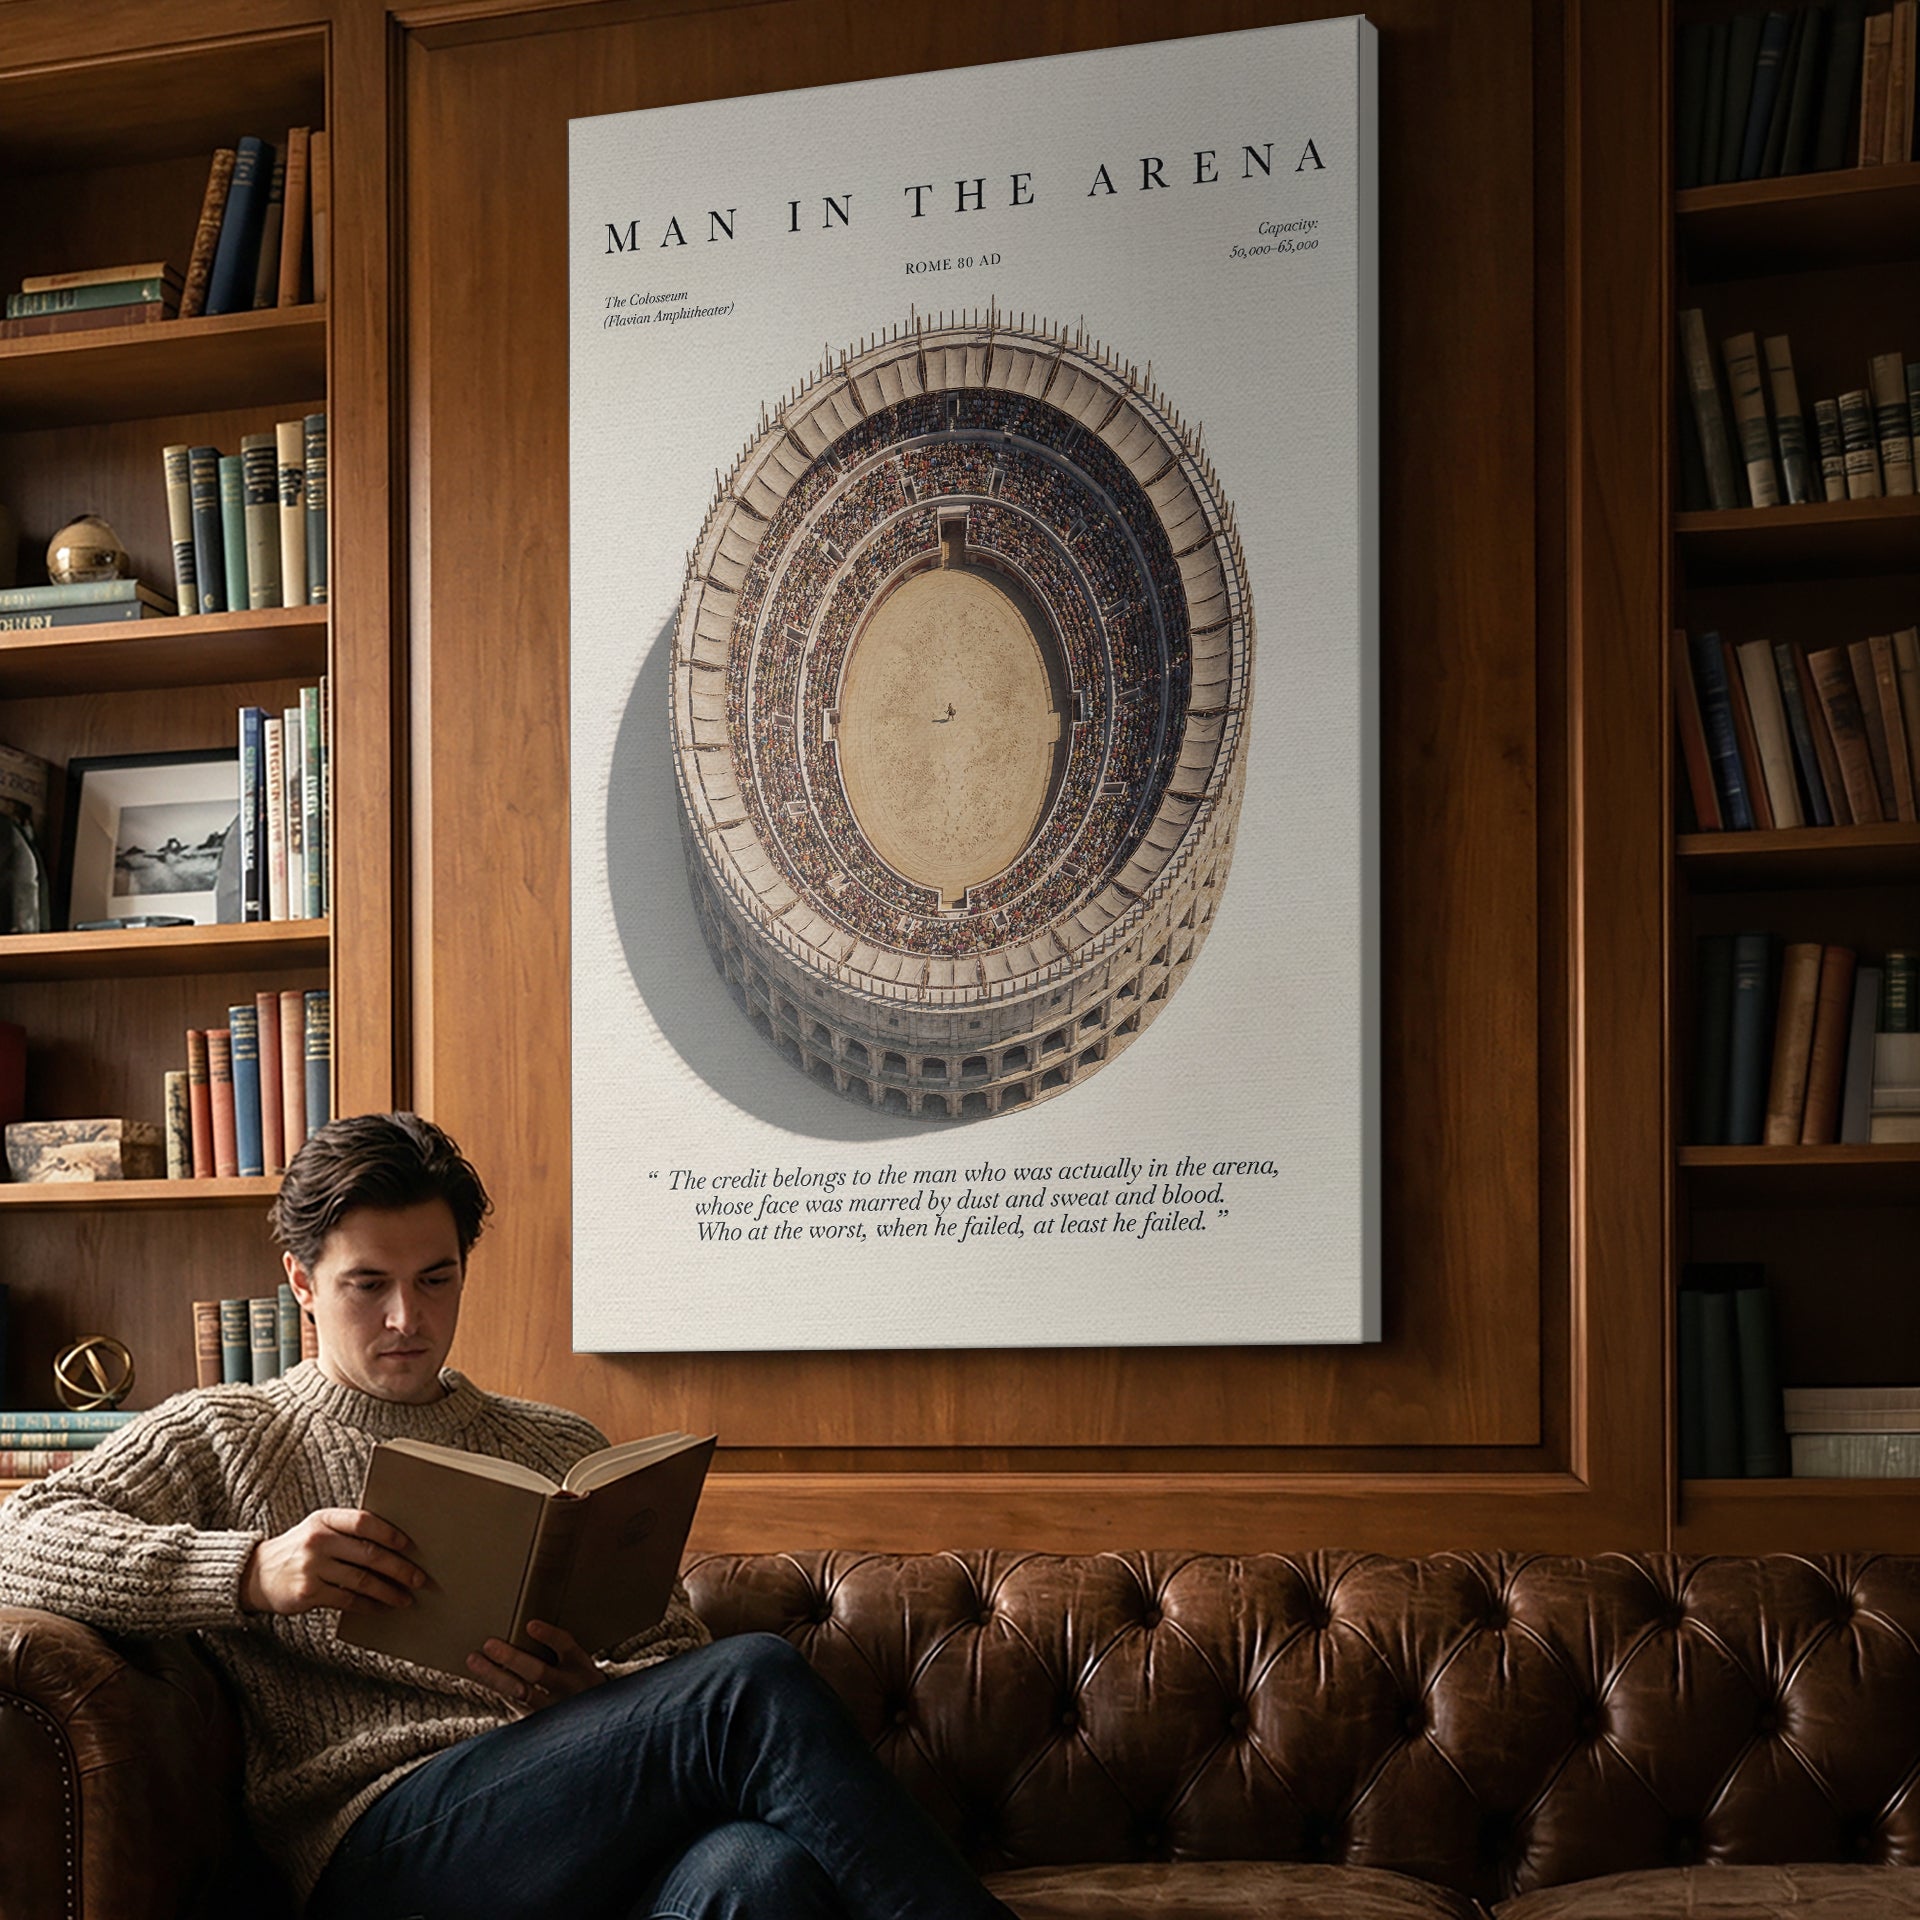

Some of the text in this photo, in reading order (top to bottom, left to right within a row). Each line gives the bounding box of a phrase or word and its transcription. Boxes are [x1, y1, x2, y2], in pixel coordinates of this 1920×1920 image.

[604, 137, 1327, 255] MAN IN THE ARENA
[1258, 218, 1319, 238] Capacity:
[905, 252, 1001, 275] ROME 80 AD
[603, 300, 735, 330] (Flavian Amphitheater)
[604, 291, 688, 309] The Colosseum
[669, 1169, 707, 1191] The
[711, 1168, 769, 1190] credit
[772, 1167, 847, 1194] belongs
[852, 1169, 872, 1187] to
[878, 1164, 908, 1186] the
[912, 1168, 958, 1184] man
[964, 1161, 1007, 1182] who
[1013, 1166, 1053, 1181] was
[1058, 1157, 1143, 1186] actually
[1148, 1158, 1168, 1178] in
[1175, 1156, 1207, 1177] the
[1212, 1159, 1280, 1178] arena,
[695, 1195, 754, 1216] whose
[753, 1193, 800, 1222] face
[805, 1198, 844, 1213] was
[848, 1190, 924, 1213] marred
[927, 1189, 952, 1217] by
[956, 1188, 1001, 1210] dust
[1005, 1186, 1048, 1208] and
[1050, 1189, 1110, 1207] sweat
[1115, 1184, 1158, 1206] and
[697, 1221, 742, 1241] Who
[747, 1224, 769, 1240] at
[773, 1220, 804, 1240] the
[809, 1222, 868, 1242] worst,
[876, 1217, 928, 1238] when
[934, 1216, 958, 1236] he
[957, 1214, 1026, 1243] failed,
[1033, 1217, 1056, 1234] at
[1060, 1213, 1109, 1234] least
[1112, 1212, 1137, 1233] he
[1137, 1211, 1207, 1240] failed.
